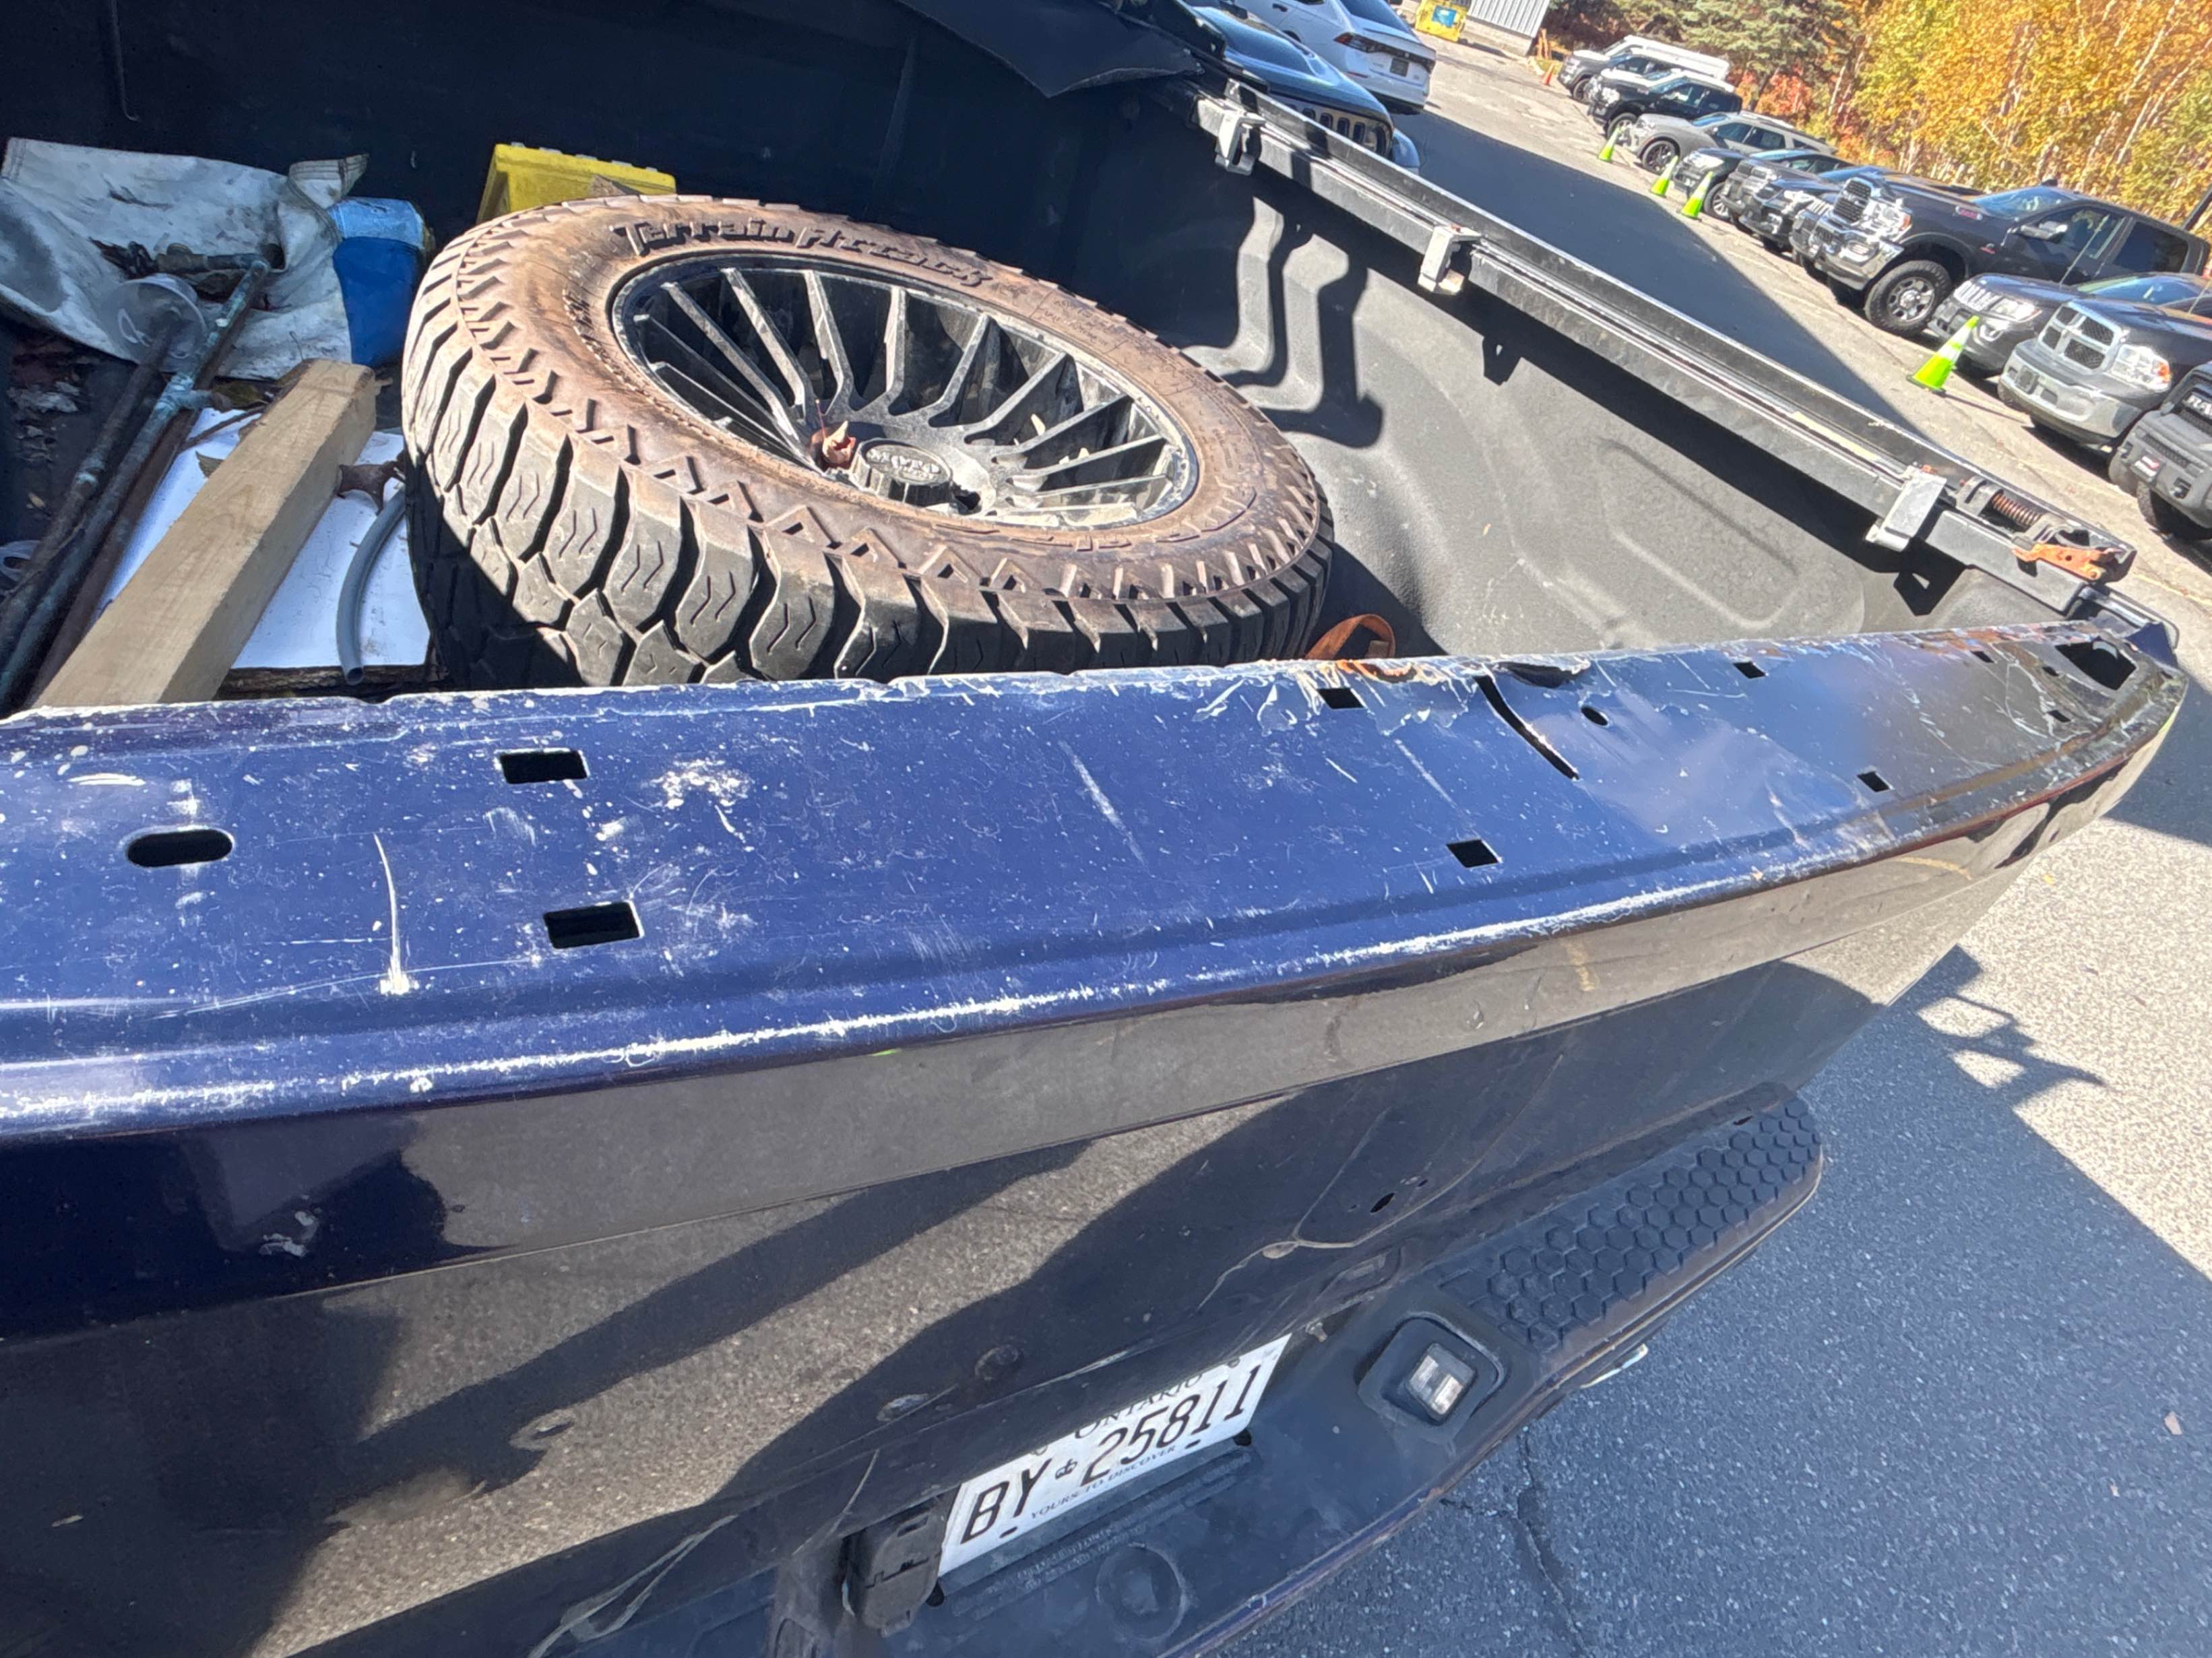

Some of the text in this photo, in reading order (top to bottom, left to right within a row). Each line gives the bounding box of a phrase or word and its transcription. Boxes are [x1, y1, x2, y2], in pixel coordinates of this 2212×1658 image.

[961, 1458, 1052, 1544] BY
[1081, 1364, 1262, 1488] 25811
[1031, 1446, 1176, 1519] YOURS TO DISCOVER
